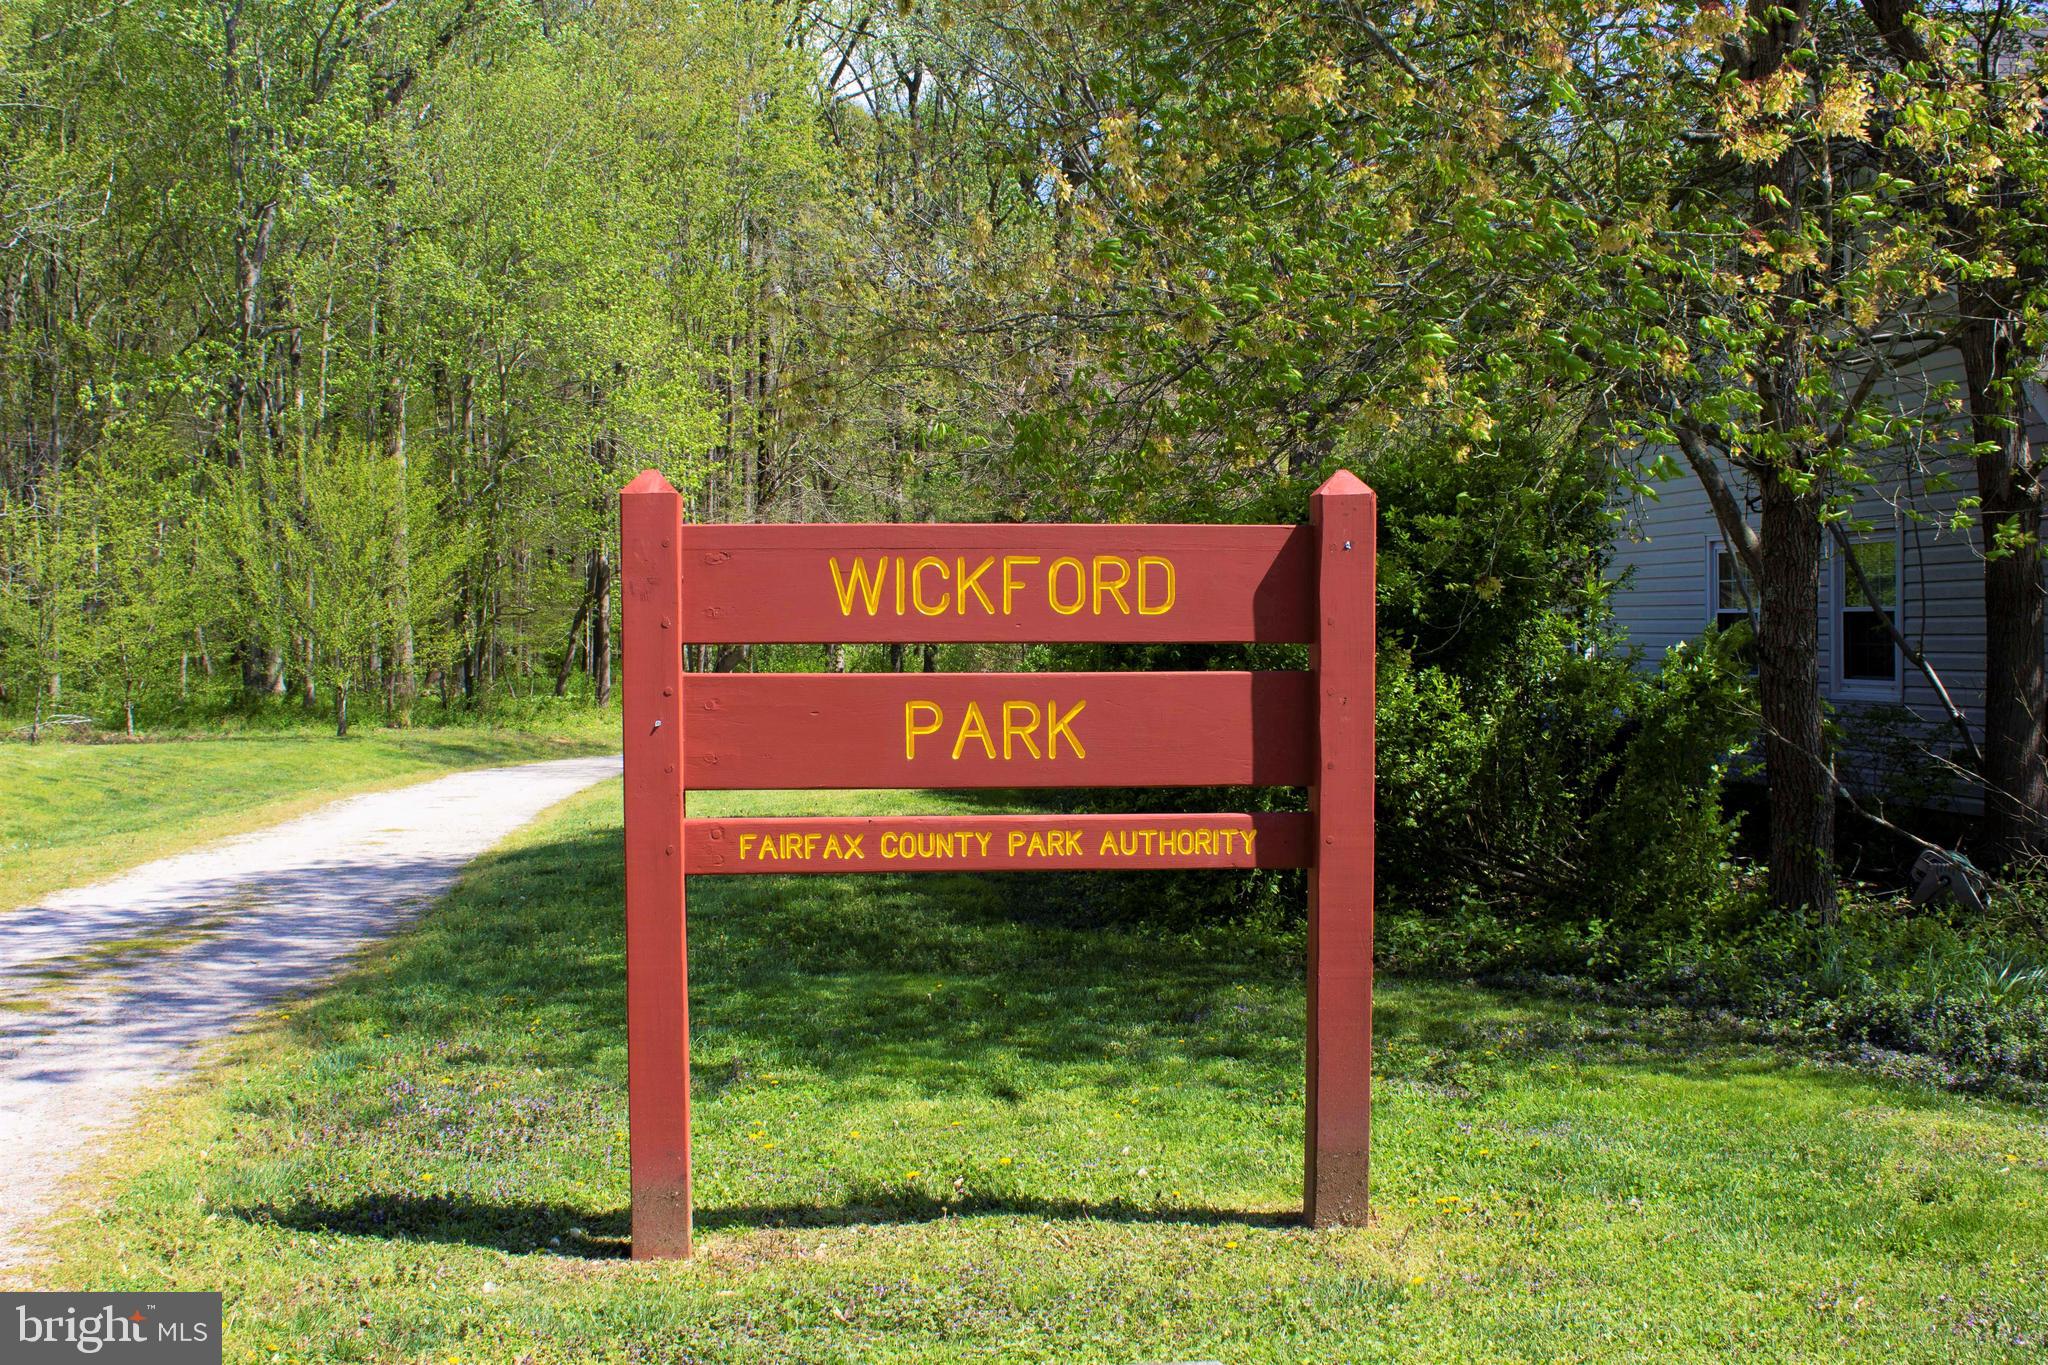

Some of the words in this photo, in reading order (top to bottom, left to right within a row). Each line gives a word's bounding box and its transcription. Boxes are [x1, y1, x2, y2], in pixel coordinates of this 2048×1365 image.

[829, 555, 1176, 616] WICKFORD
[905, 700, 1087, 760] PARK
[739, 832, 865, 860] FAIRFAX
[880, 831, 993, 858] COUNTY
[1008, 830, 1083, 857] PARK
[1100, 828, 1258, 857] AUTHORITY
